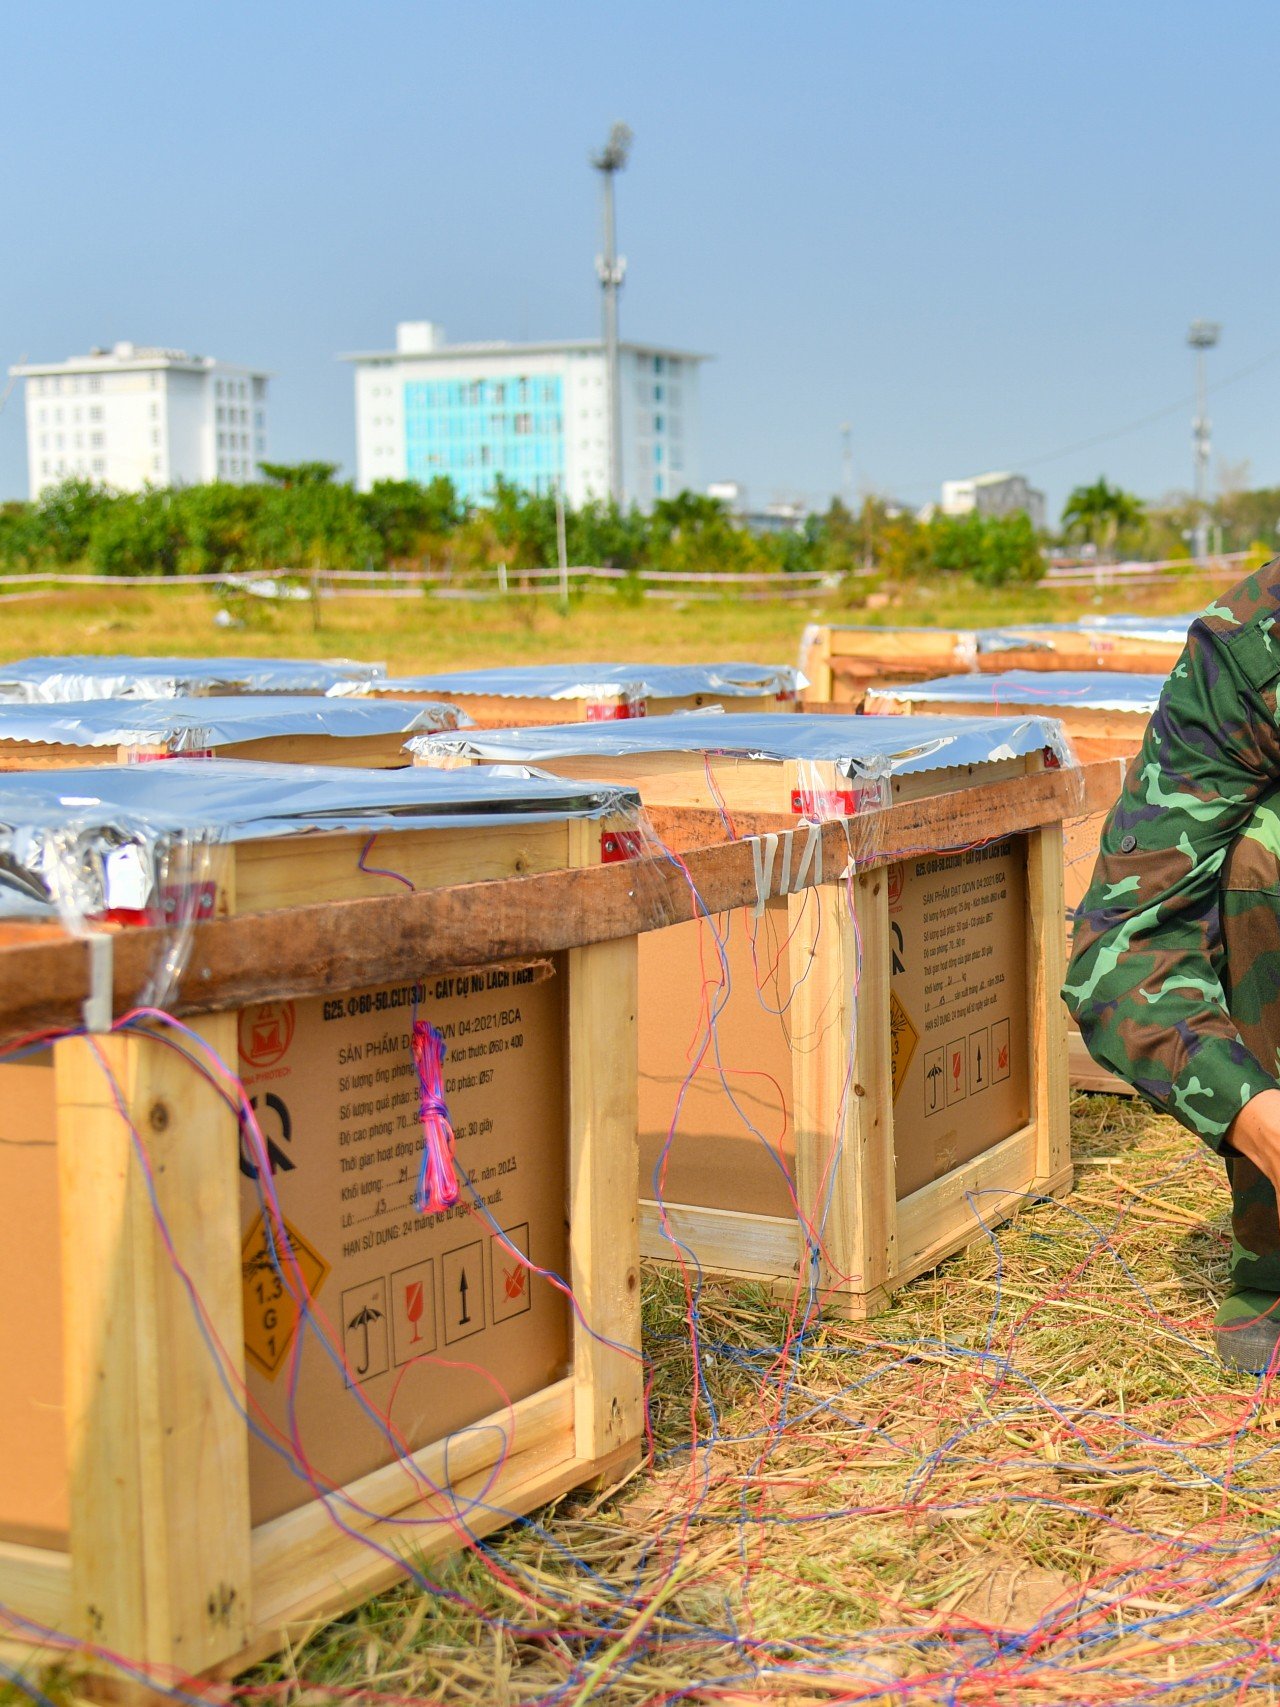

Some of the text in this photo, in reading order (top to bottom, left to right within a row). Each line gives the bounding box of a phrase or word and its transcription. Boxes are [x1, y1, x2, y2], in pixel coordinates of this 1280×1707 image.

[459, 1008, 522, 1037] 04:2021/BCA
[263, 1309, 278, 1330] G
[267, 1339, 276, 1356] 1
